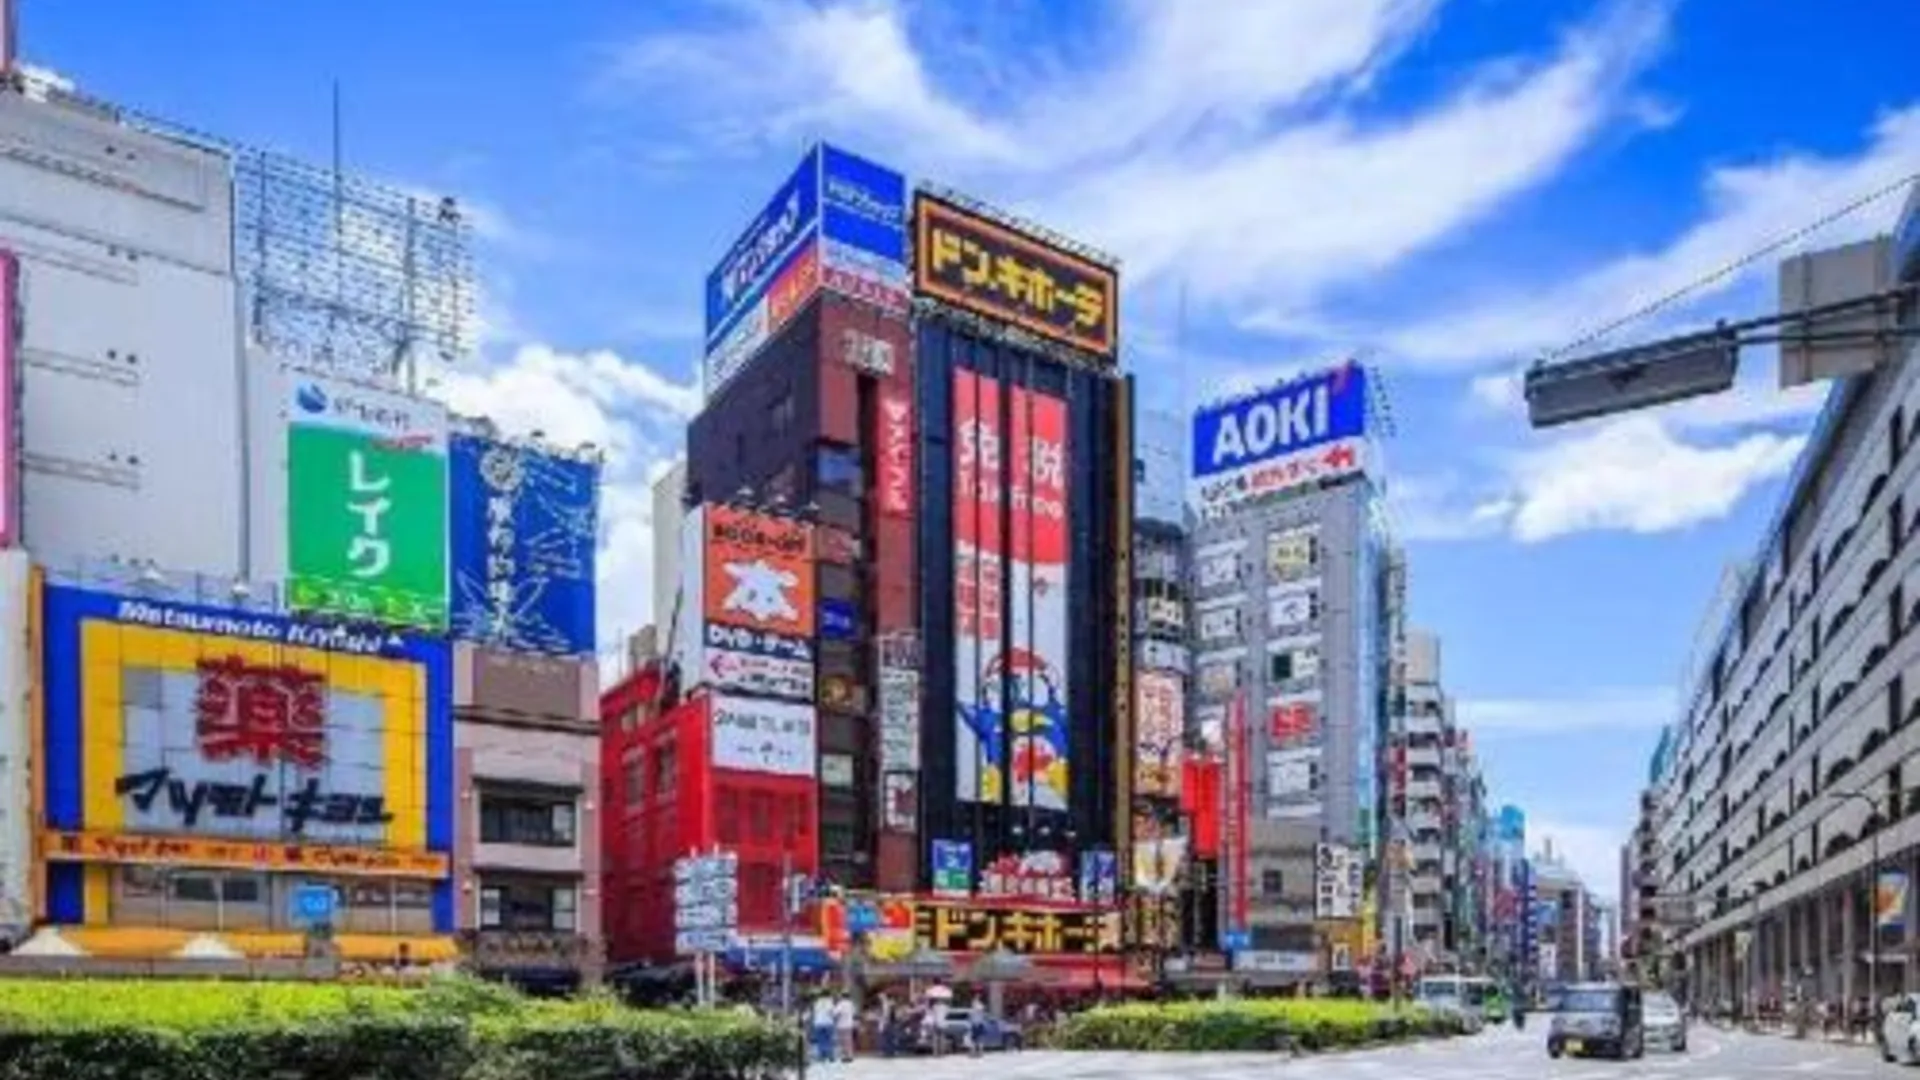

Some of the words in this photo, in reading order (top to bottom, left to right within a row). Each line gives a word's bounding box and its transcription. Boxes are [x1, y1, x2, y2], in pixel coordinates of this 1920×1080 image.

[1212, 384, 1329, 465] AOKI
[345, 450, 392, 578] レイク
[117, 600, 281, 638] Matsumoto
[195, 653, 325, 769] 薬
